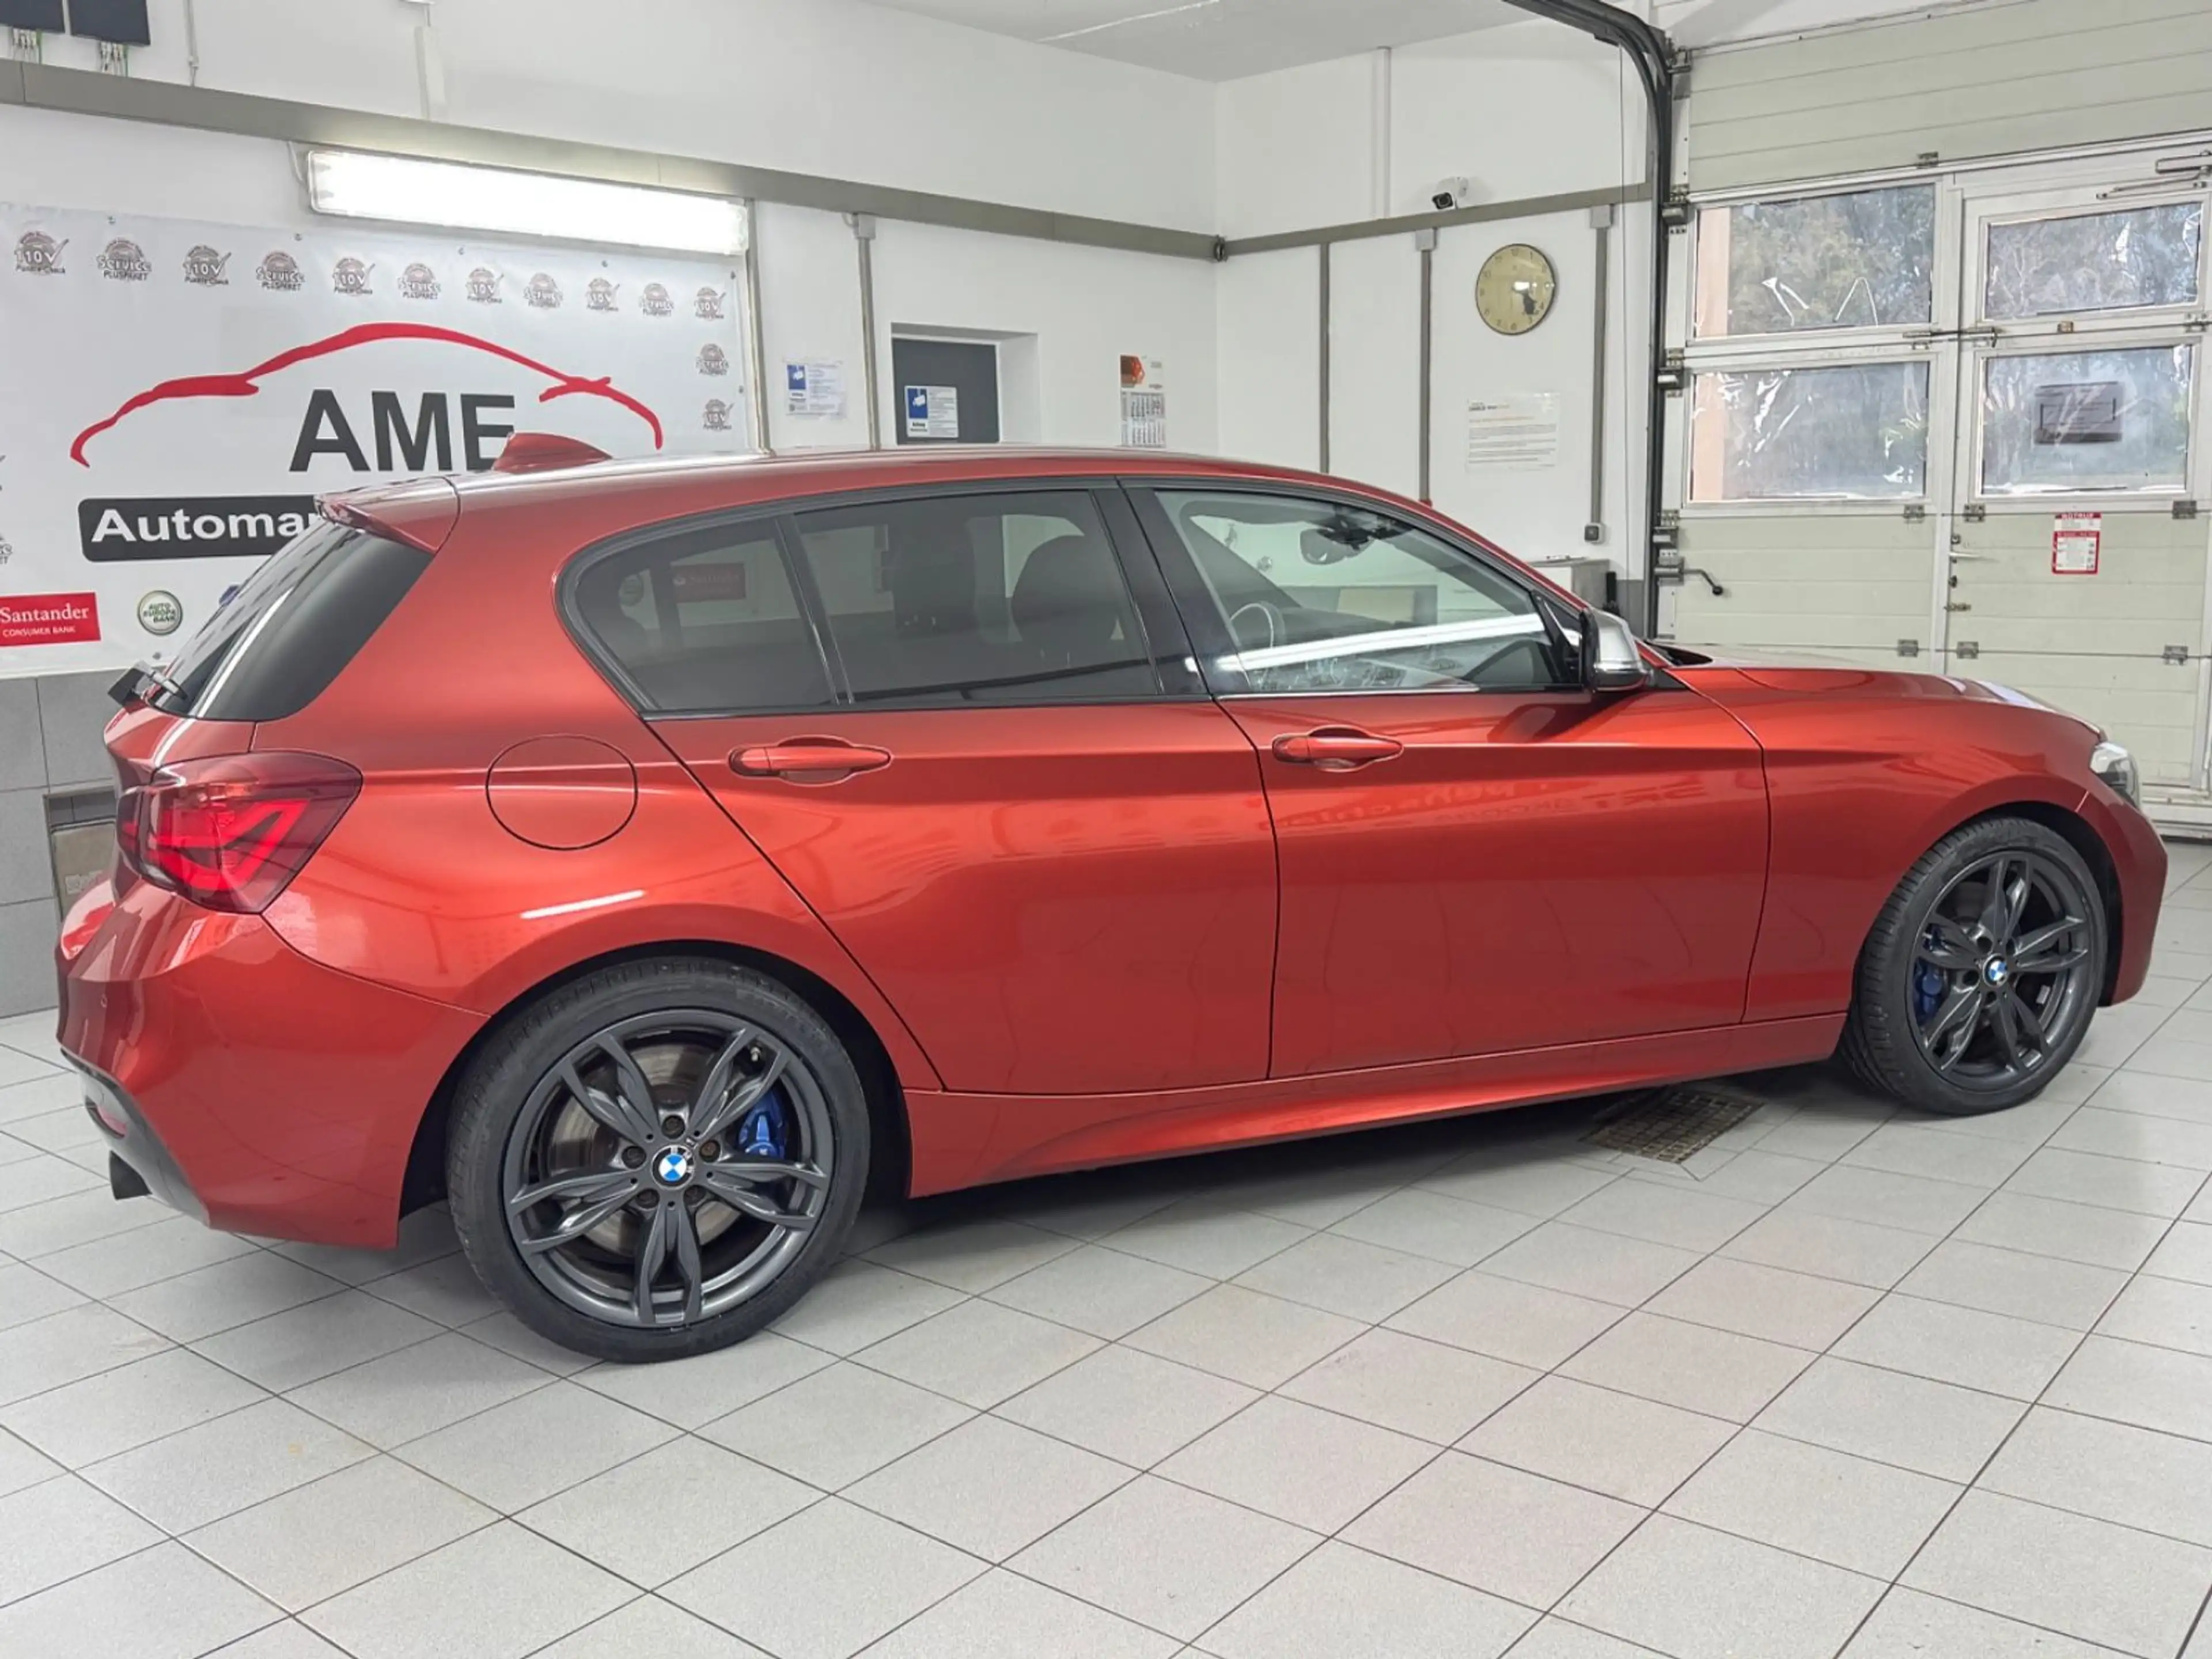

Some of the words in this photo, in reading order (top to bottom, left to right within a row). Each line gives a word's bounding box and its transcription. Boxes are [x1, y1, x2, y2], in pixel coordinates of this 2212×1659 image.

[289, 389, 514, 472] AME
[0, 603, 89, 623] Santander
[2, 627, 51, 638] CONSUMER
[52, 626, 76, 634] BANK
